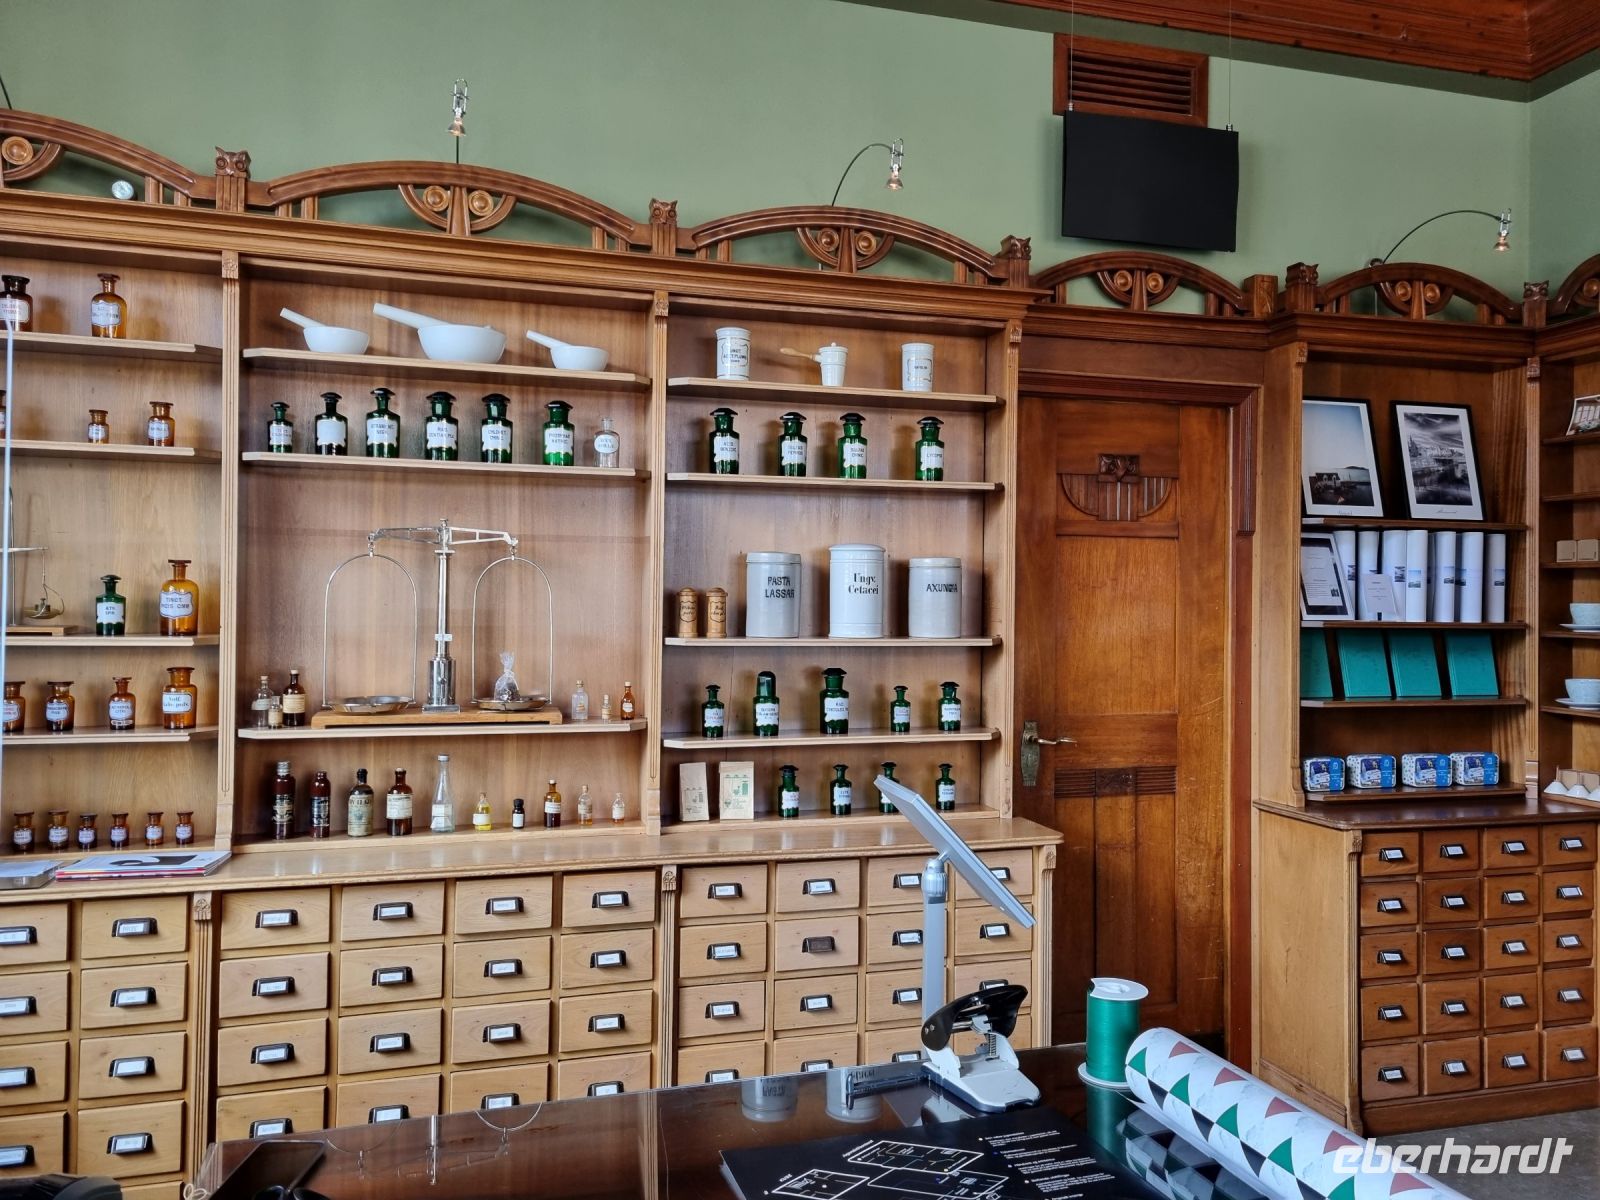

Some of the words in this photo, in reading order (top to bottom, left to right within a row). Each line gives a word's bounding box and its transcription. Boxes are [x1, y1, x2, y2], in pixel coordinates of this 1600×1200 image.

[767, 576, 791, 586] PASTA
[765, 588, 795, 599] LASSAR
[848, 585, 879, 595] Cetacei
